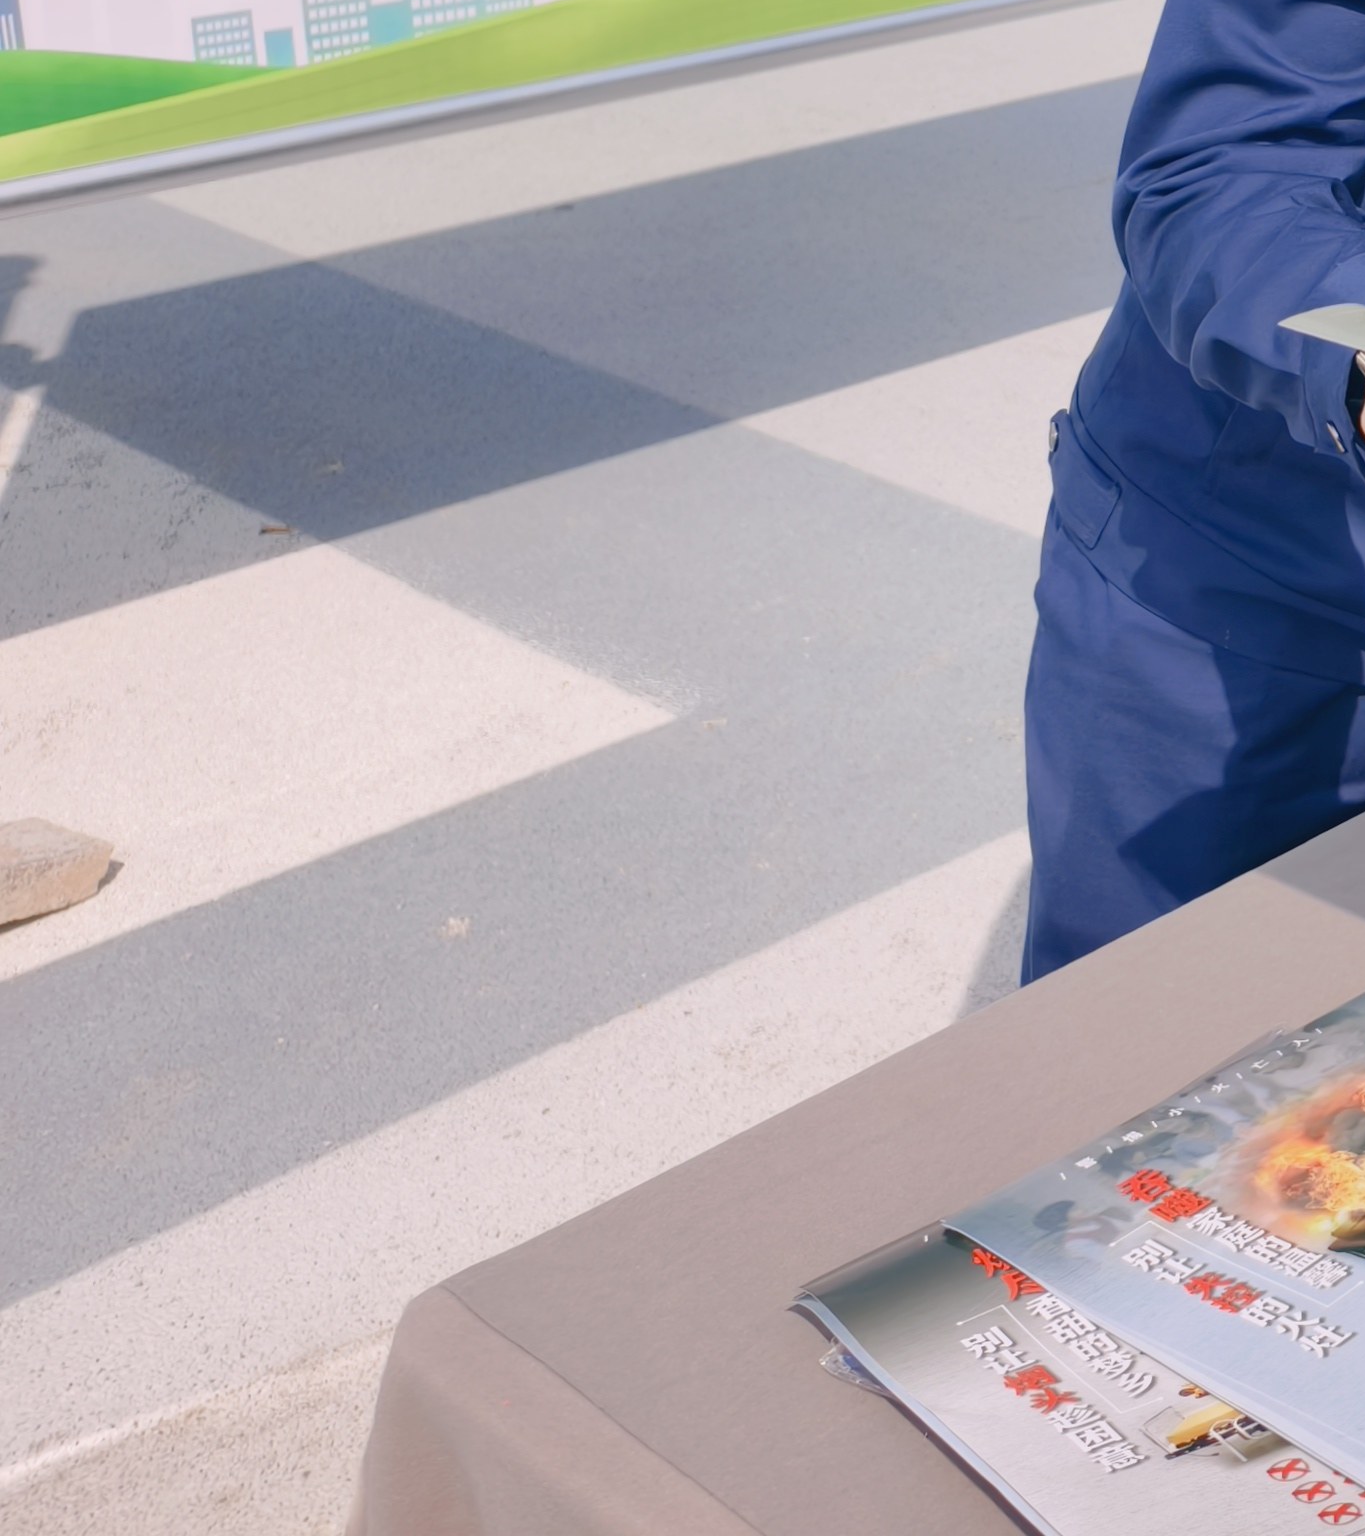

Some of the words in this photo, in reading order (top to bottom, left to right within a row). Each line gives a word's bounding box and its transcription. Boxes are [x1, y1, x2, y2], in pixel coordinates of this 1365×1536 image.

[1116, 1168, 1354, 1290] 吞噬家庭的温馨
[1121, 1238, 1357, 1358] 别让失控的火灶
[960, 1326, 1148, 1474] 别让烟头趁困意
